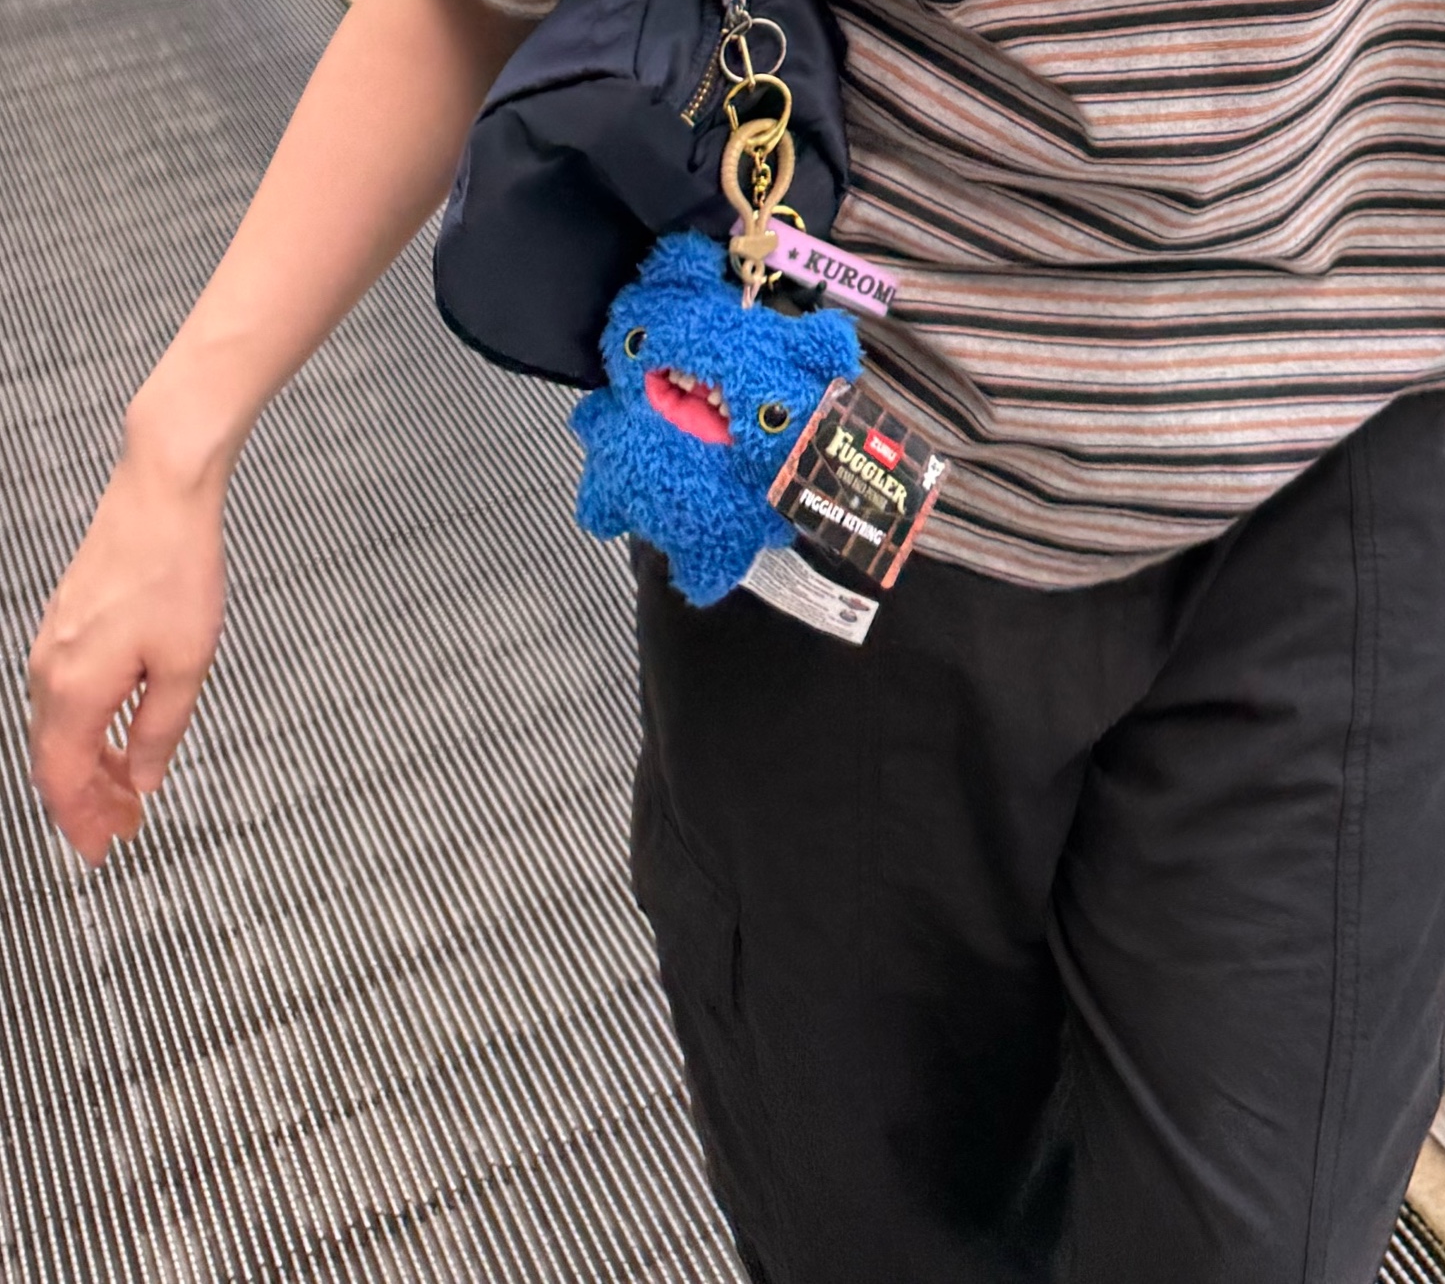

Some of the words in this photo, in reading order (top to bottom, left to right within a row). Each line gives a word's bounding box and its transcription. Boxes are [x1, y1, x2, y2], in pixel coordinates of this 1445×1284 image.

[825, 425, 908, 516] FUGGLER
[800, 488, 844, 524] FUGGLER
[842, 512, 886, 547] KEYRING
